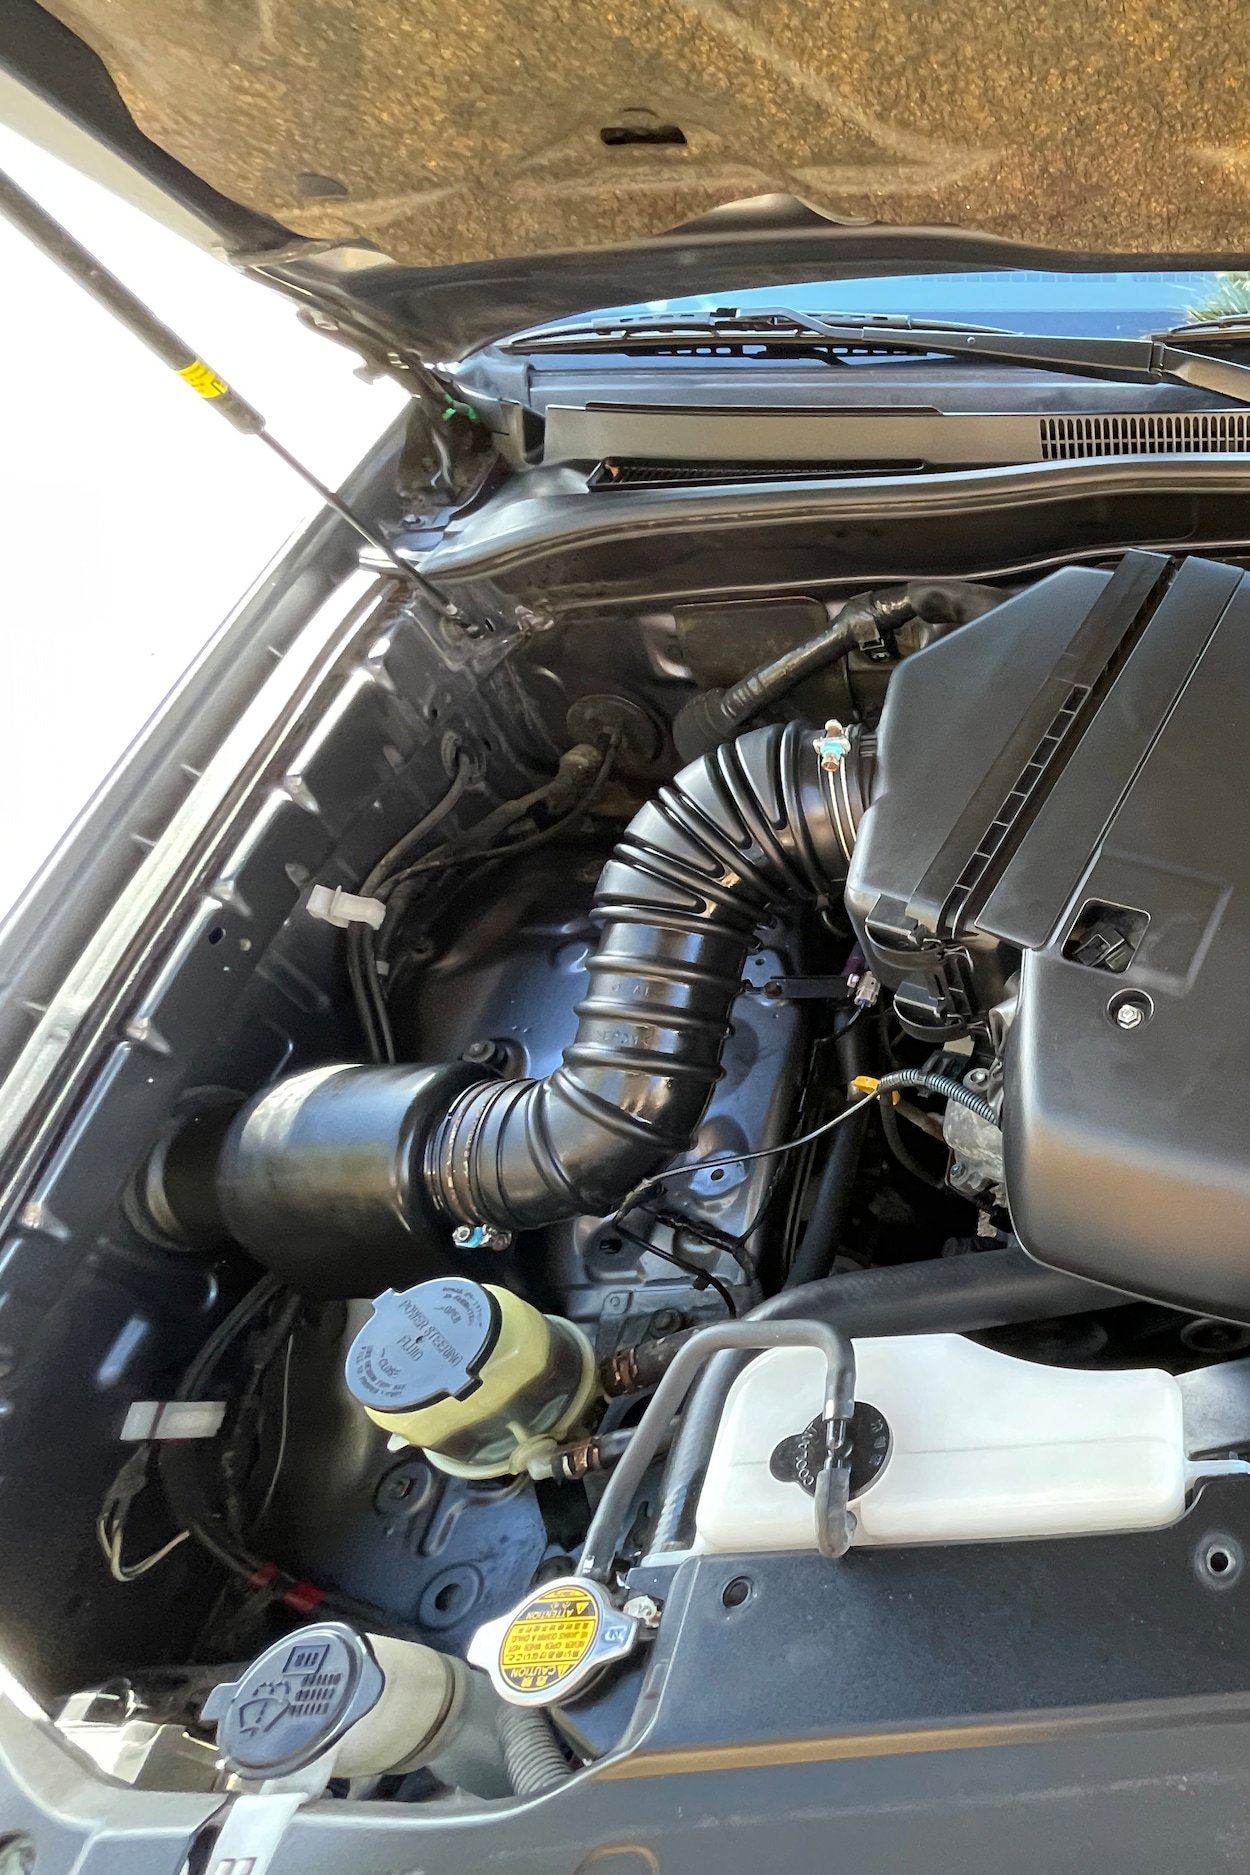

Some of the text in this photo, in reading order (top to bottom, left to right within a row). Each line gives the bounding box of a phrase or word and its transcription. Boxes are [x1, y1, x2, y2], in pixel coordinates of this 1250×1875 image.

[398, 1299, 429, 1335] POWER
[423, 1325, 464, 1368] STEERING
[397, 1334, 424, 1362] FLUID
[525, 1608, 574, 1620] ATTENTION
[544, 1642, 562, 1650] OPEN
[510, 1664, 557, 1678] CAUTION
